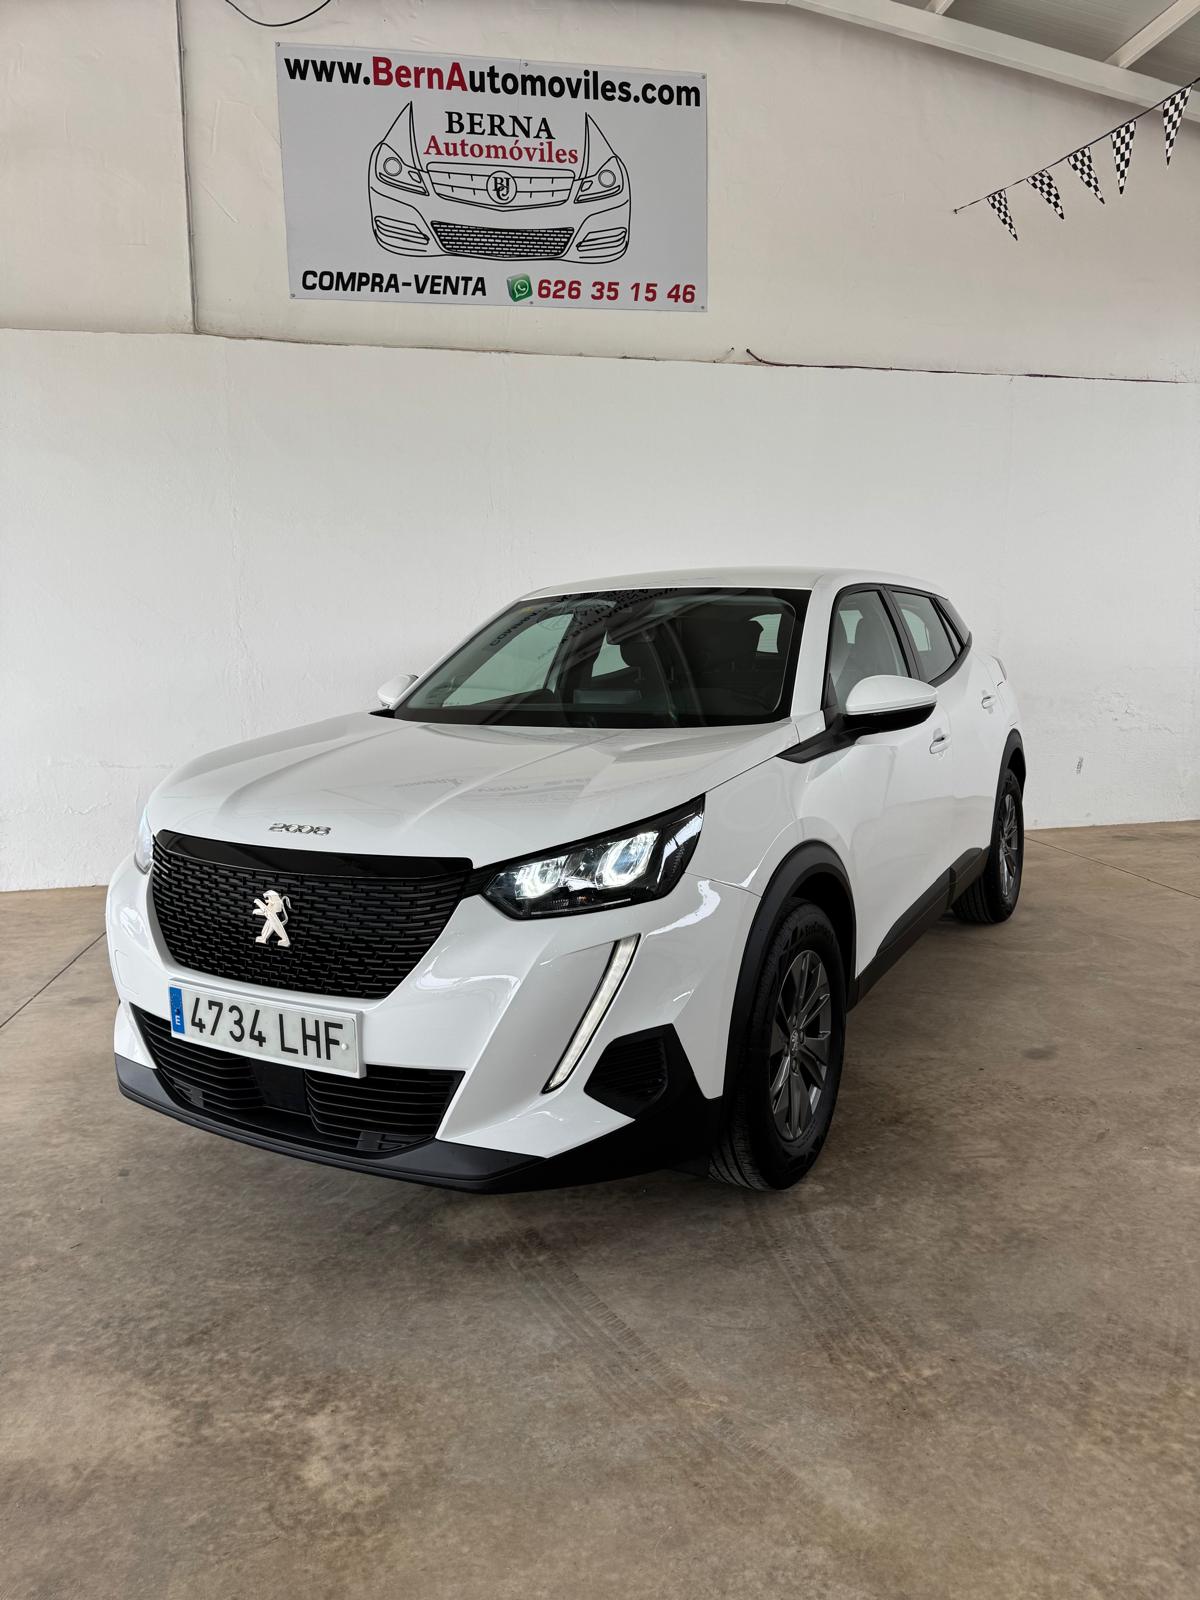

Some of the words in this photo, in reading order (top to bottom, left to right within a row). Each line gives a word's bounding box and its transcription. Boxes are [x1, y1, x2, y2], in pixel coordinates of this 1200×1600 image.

[284, 56, 701, 107] www.BernAutomoviles.com
[445, 111, 556, 140] BERNA
[423, 135, 578, 164] Automóviles
[302, 270, 487, 297] COMPRA-VENTA
[537, 279, 582, 300] 626
[590, 281, 620, 301] 35
[630, 282, 658, 302] 15
[667, 283, 696, 304] 46
[268, 822, 331, 836] 2008
[191, 997, 266, 1047] 4734
[279, 1013, 344, 1061] LHF
